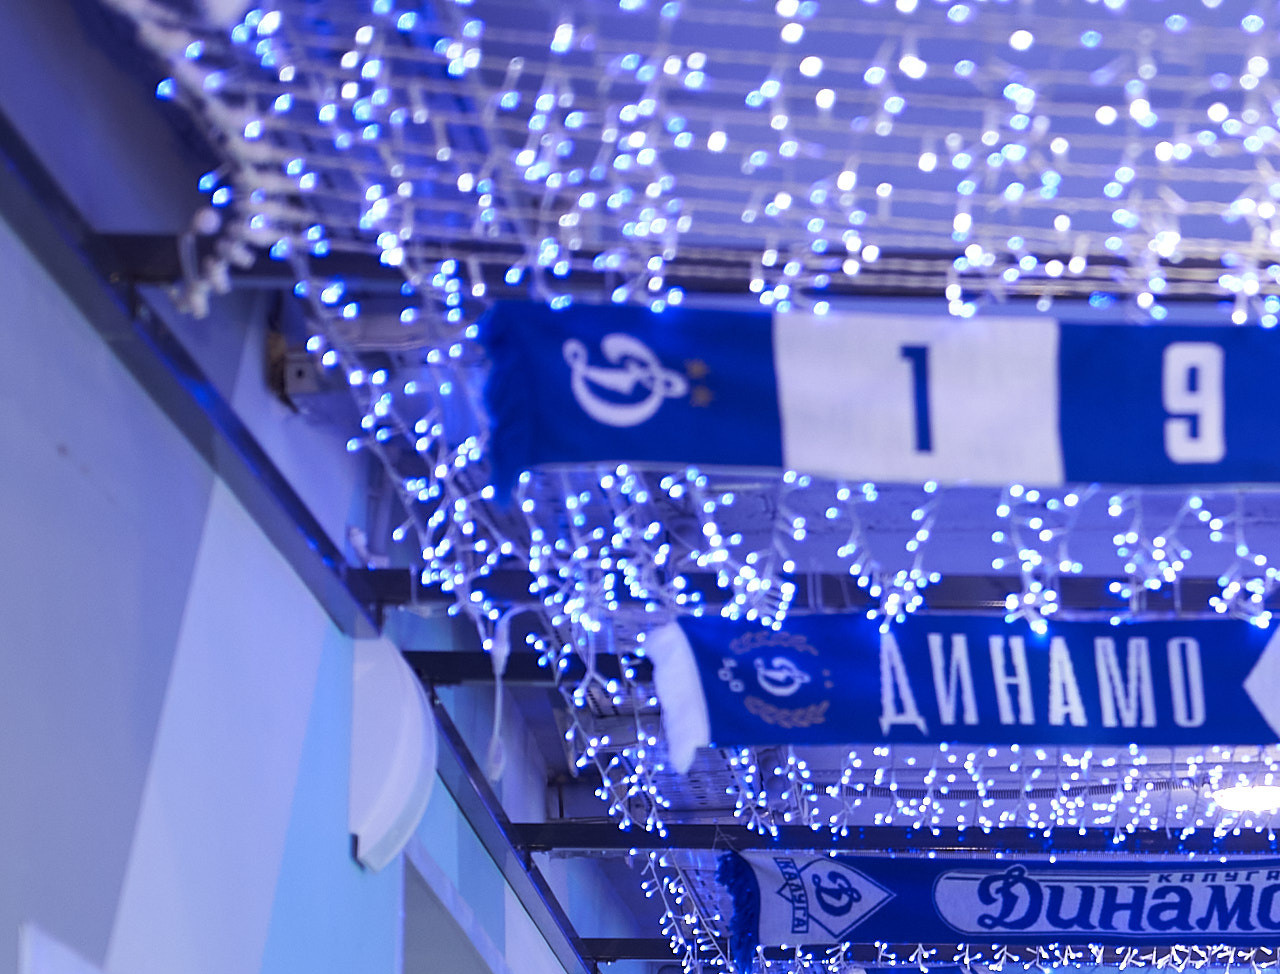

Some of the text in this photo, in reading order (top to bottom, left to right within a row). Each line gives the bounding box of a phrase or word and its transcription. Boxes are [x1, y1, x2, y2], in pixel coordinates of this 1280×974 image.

[900, 345, 933, 454] 1
[1163, 341, 1226, 464] 9
[879, 632, 1206, 737] ДИНАМО
[775, 858, 808, 932] КАЛУГА
